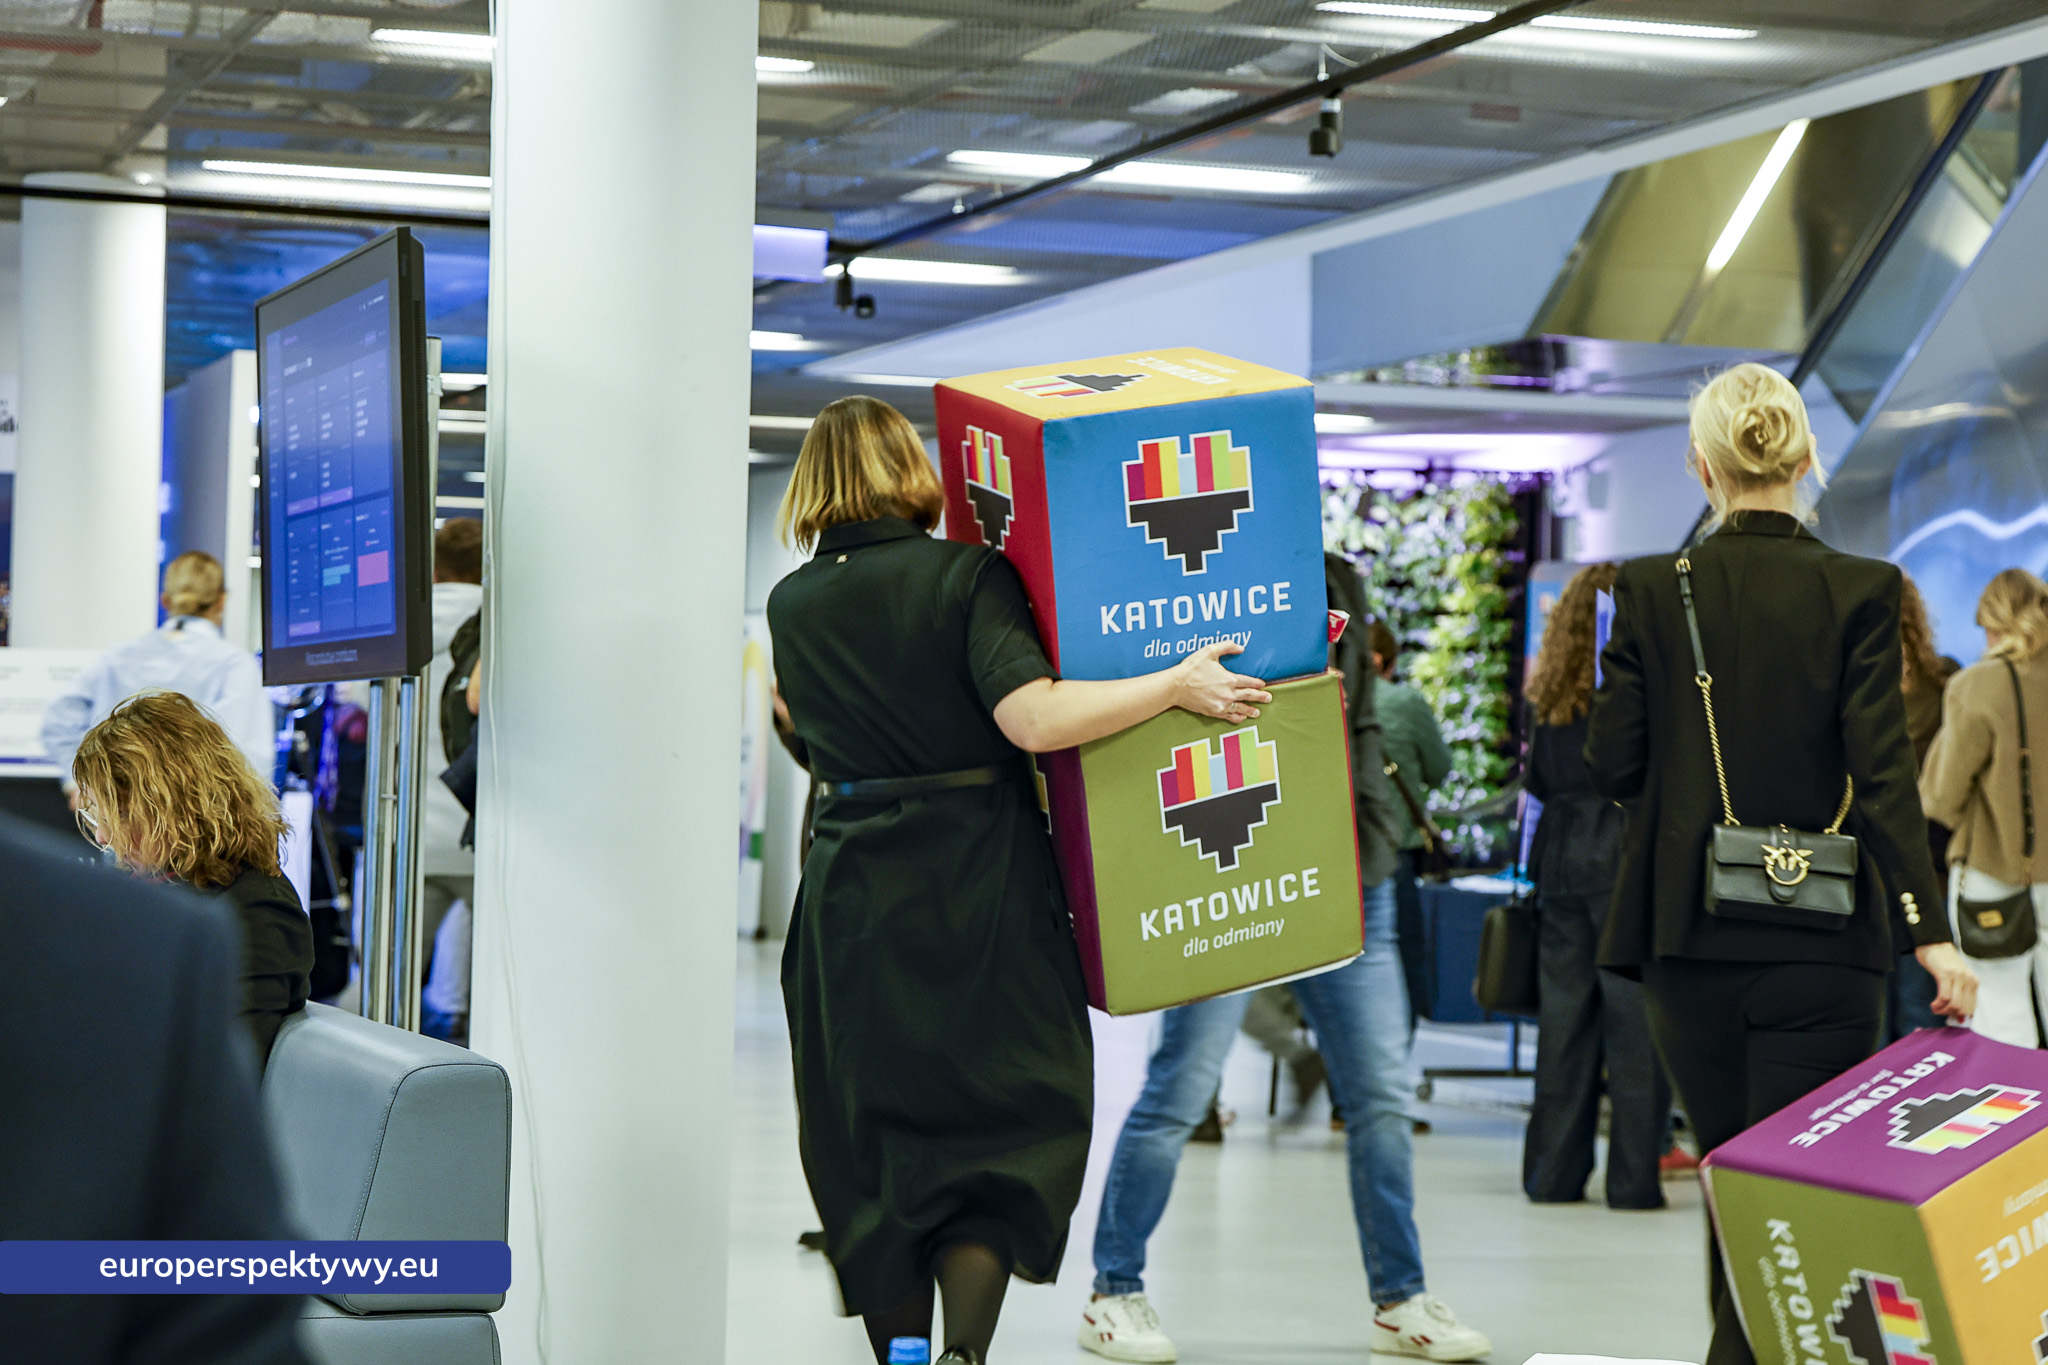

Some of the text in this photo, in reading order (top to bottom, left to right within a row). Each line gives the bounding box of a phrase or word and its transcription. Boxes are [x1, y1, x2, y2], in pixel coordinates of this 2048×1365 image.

[1101, 582, 1292, 635] KATOWICE
[1144, 639, 1171, 659] dla
[1140, 867, 1321, 941] KATOWICE
[1183, 918, 1285, 958] dla odmiany
[1788, 1051, 1956, 1148] KATOWICE
